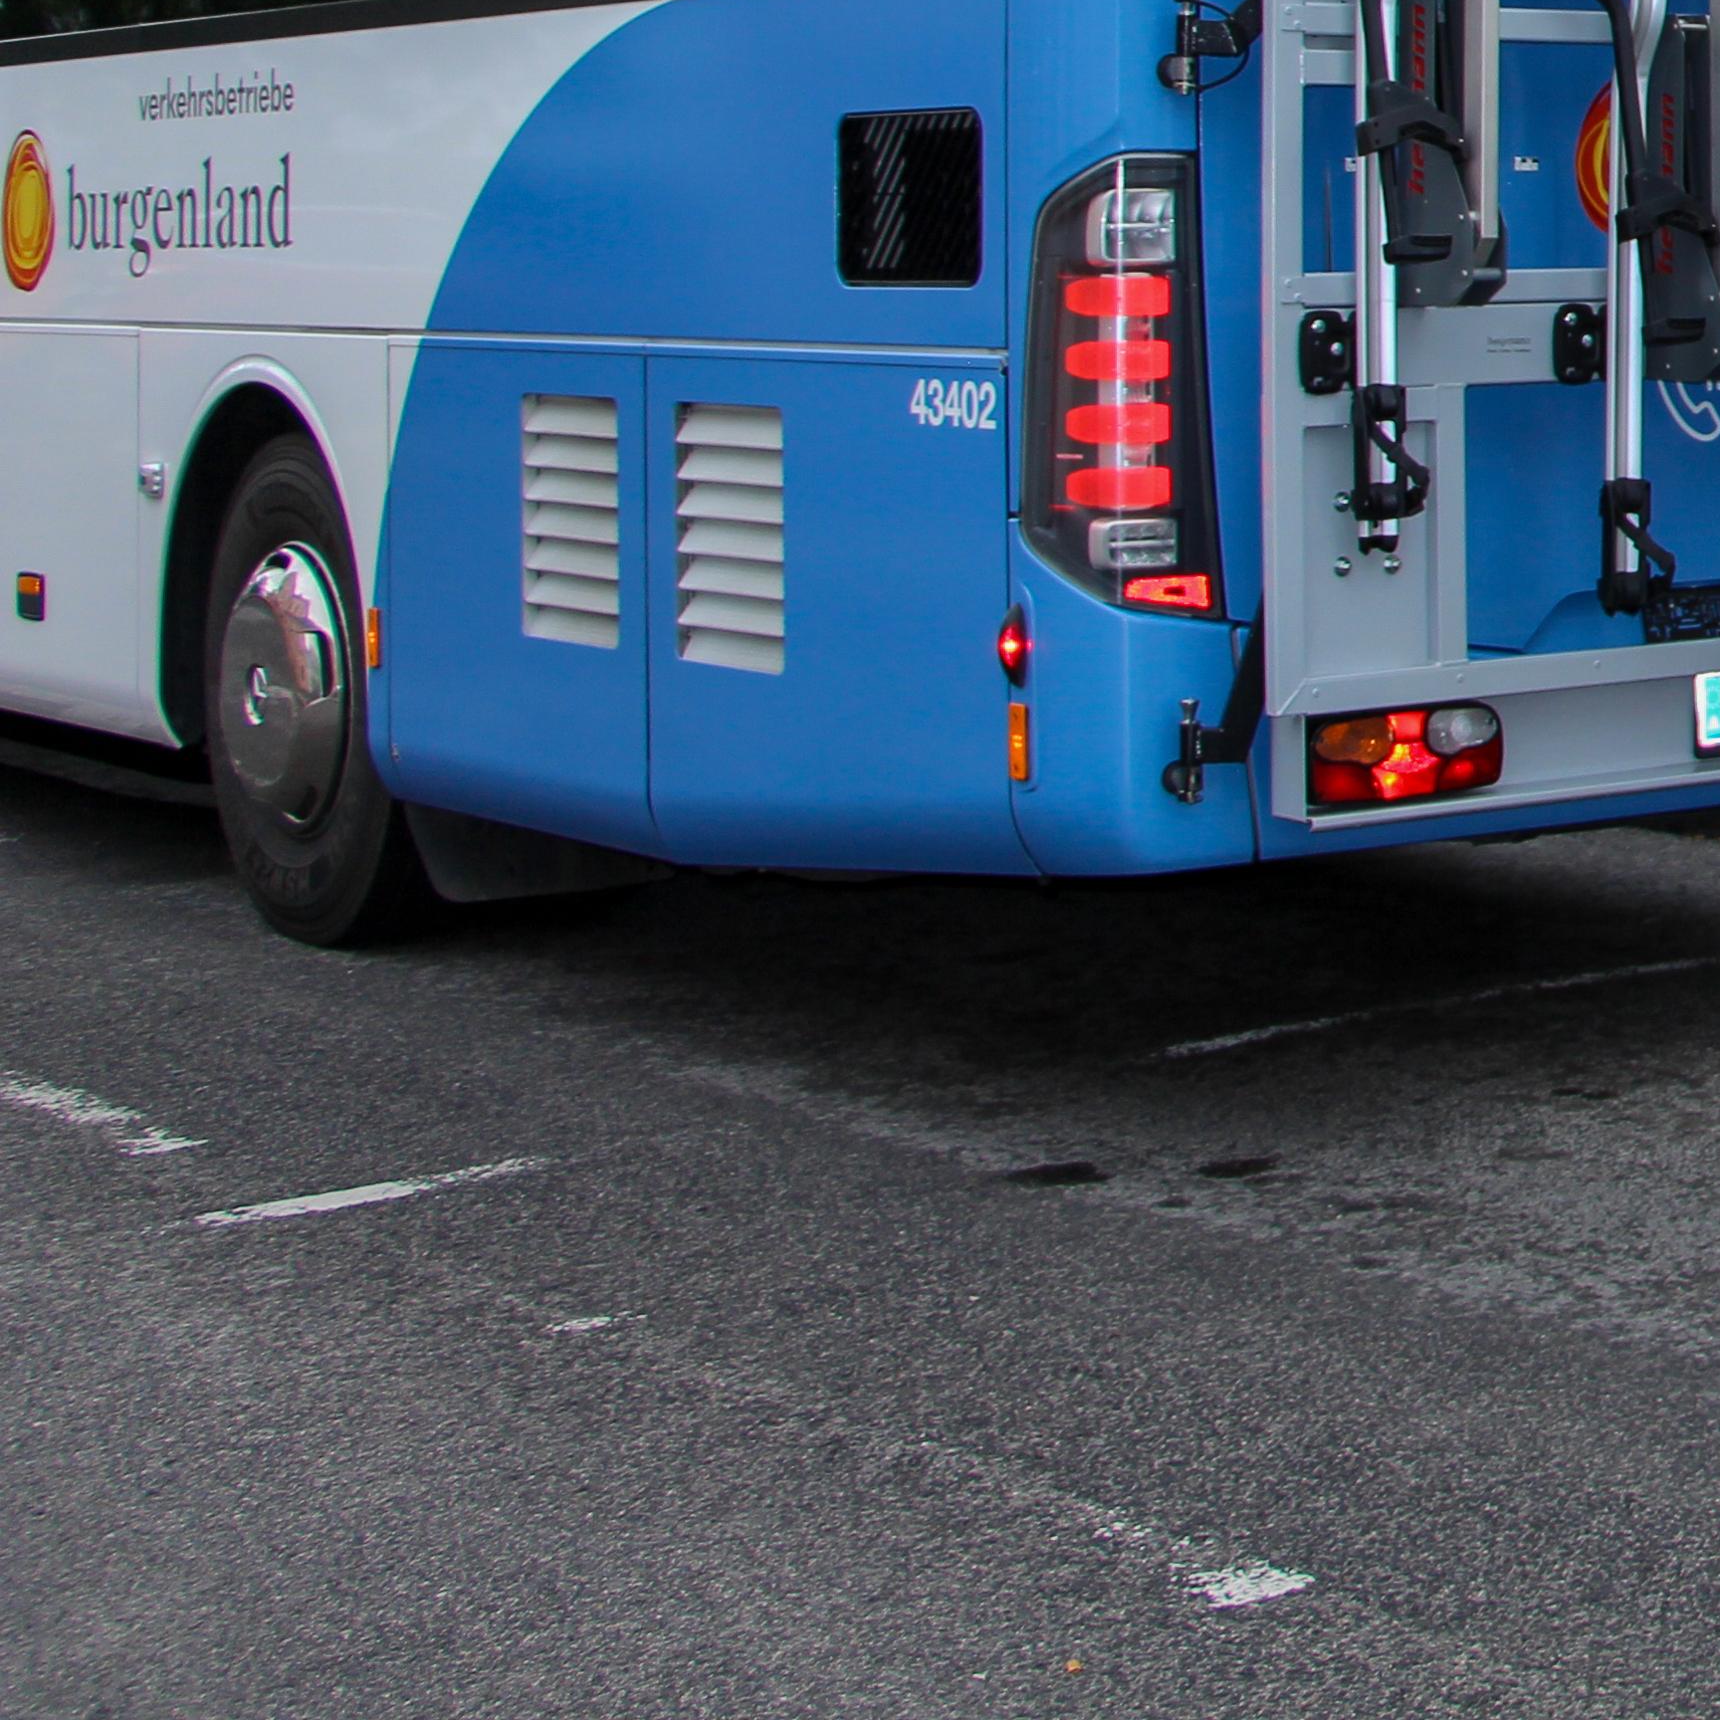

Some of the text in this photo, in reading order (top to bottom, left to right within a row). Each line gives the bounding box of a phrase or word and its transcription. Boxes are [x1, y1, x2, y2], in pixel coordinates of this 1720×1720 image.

[138, 68, 295, 121] verkehrsbetriebe
[1407, 3, 1426, 195] heann
[66, 151, 294, 278] burgenland
[909, 378, 998, 430] 43402
